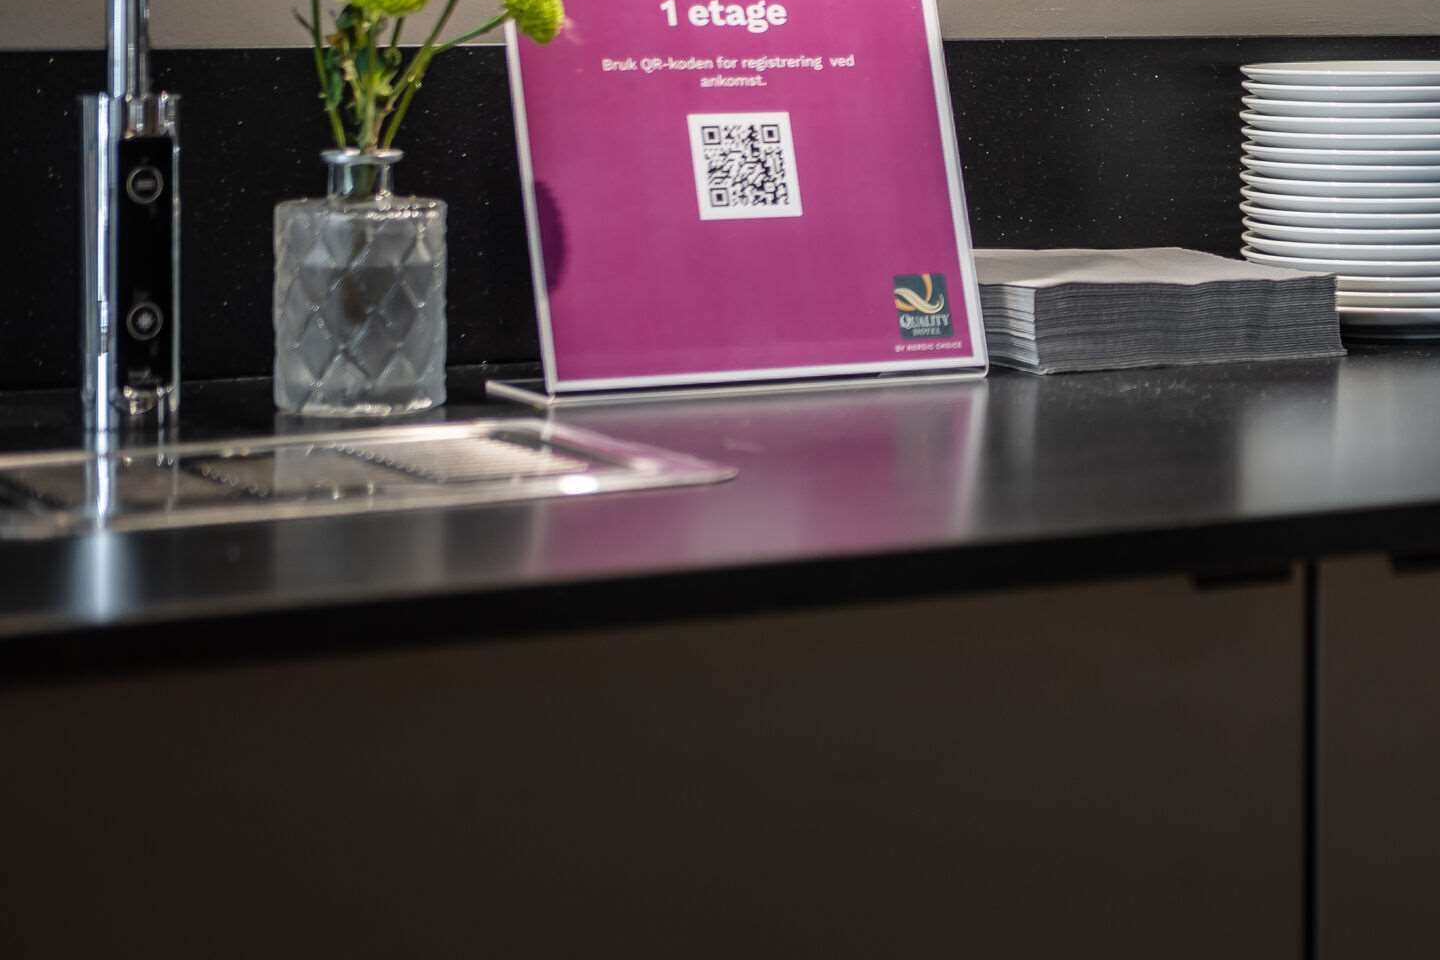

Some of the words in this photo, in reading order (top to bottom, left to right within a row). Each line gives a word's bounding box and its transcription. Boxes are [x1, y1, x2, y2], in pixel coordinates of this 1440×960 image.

[660, 0, 679, 26] 1
[688, 0, 788, 33] etage
[602, 58, 637, 71] Bruk
[640, 57, 714, 73] QR-koden
[716, 56, 737, 69] for
[741, 55, 823, 71] registrering
[829, 54, 855, 68] ved
[700, 74, 767, 88] ankomst.
